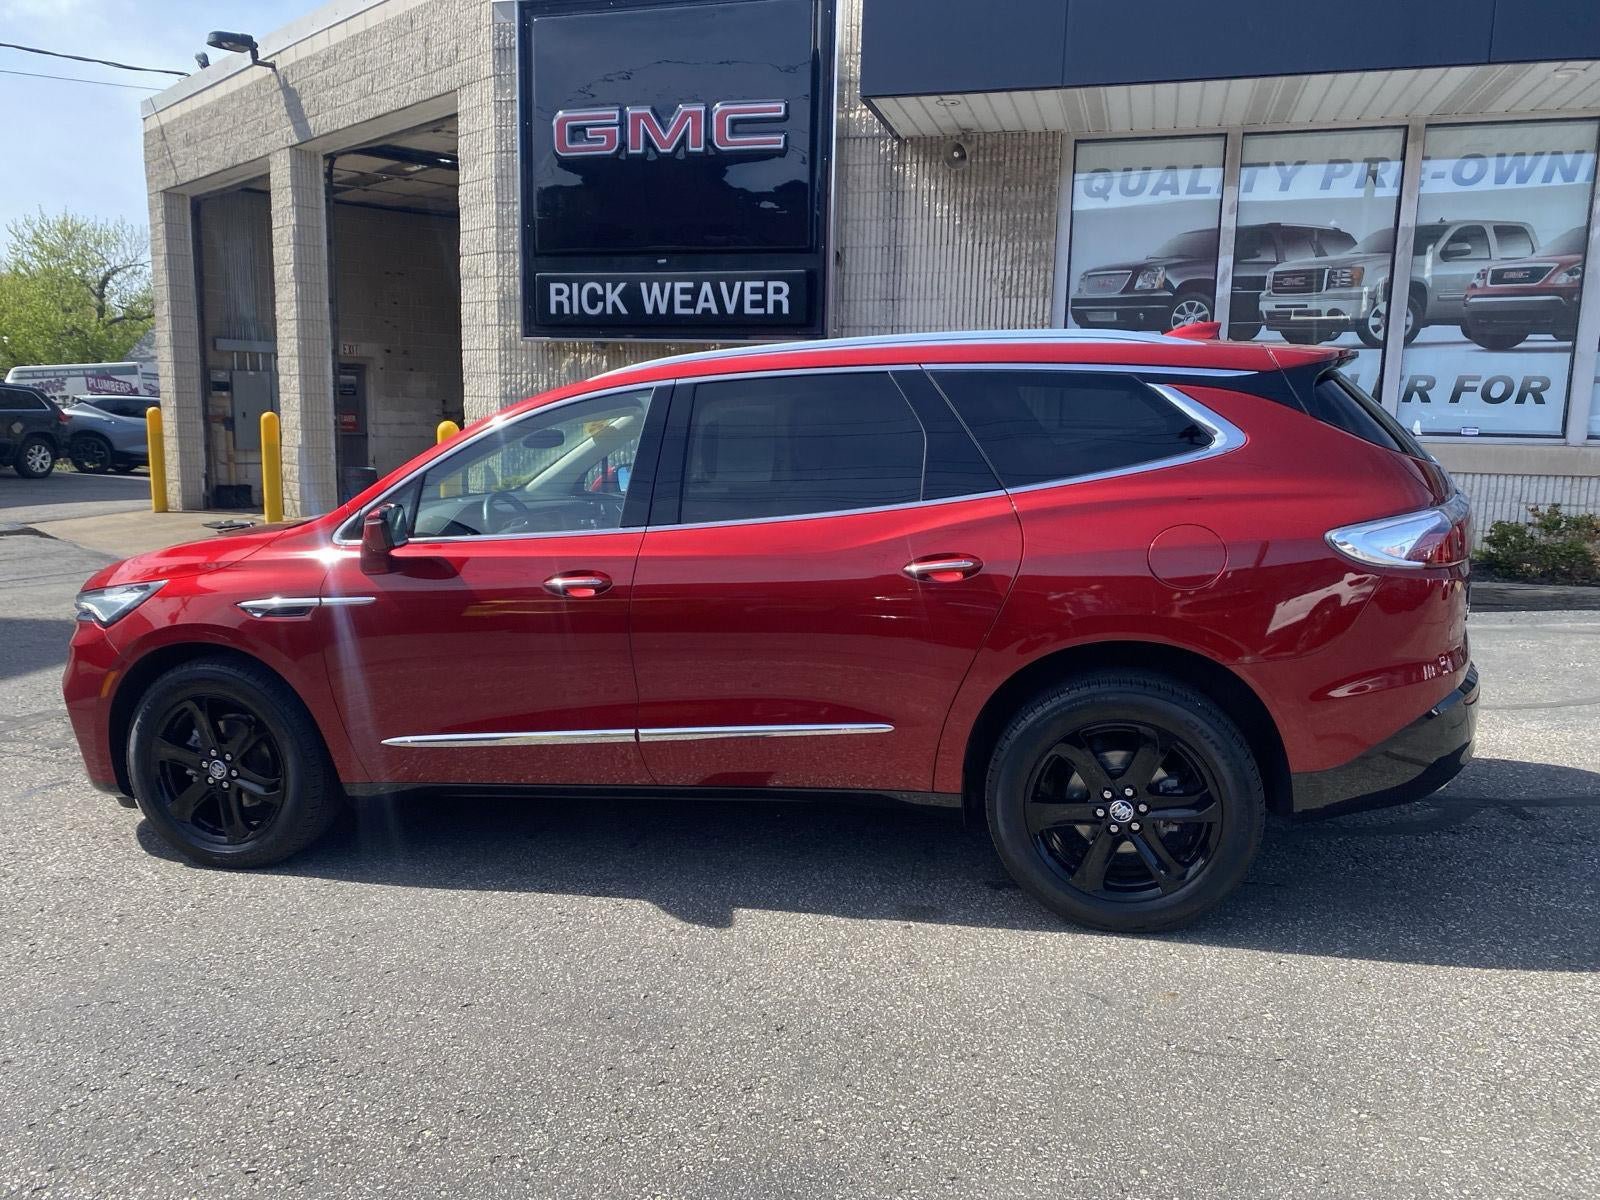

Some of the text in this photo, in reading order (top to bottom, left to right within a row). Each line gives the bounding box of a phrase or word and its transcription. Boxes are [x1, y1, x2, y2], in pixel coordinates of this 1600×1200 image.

[553, 100, 788, 156] GMC
[1320, 150, 1594, 191] PR-OWN
[549, 280, 790, 315] RICK WEAVER
[87, 377, 131, 393] PLUMBERS
[1448, 375, 1551, 405] FOR
